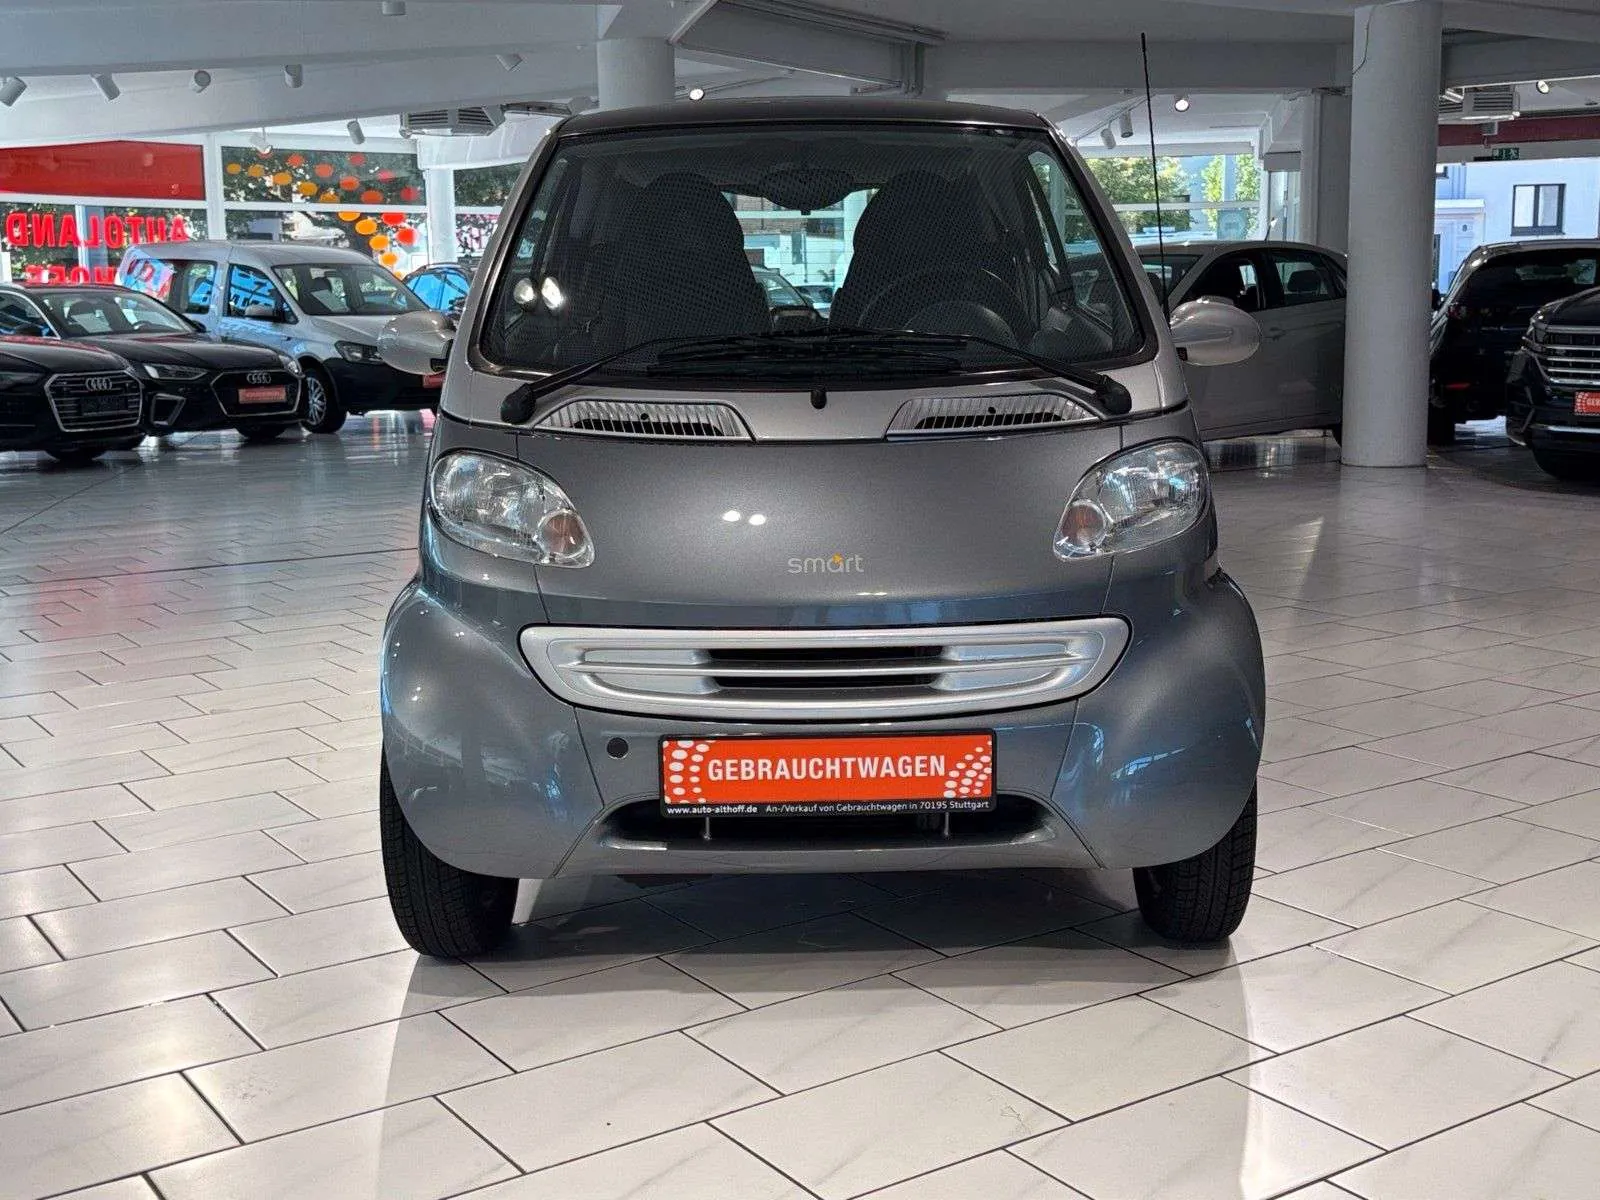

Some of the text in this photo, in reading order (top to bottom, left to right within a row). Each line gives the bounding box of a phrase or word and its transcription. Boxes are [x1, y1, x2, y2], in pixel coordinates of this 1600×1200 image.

[787, 552, 865, 574] smart
[707, 754, 946, 781] GEBRAUCHTWAGEN
[667, 804, 758, 814] www.auto-althoff.de
[766, 804, 817, 813] An-/Verkauf
[819, 804, 834, 812] von
[836, 802, 908, 812] Gebrauchtwagen
[920, 801, 947, 809] 70195
[950, 801, 989, 810] Stuttgart
